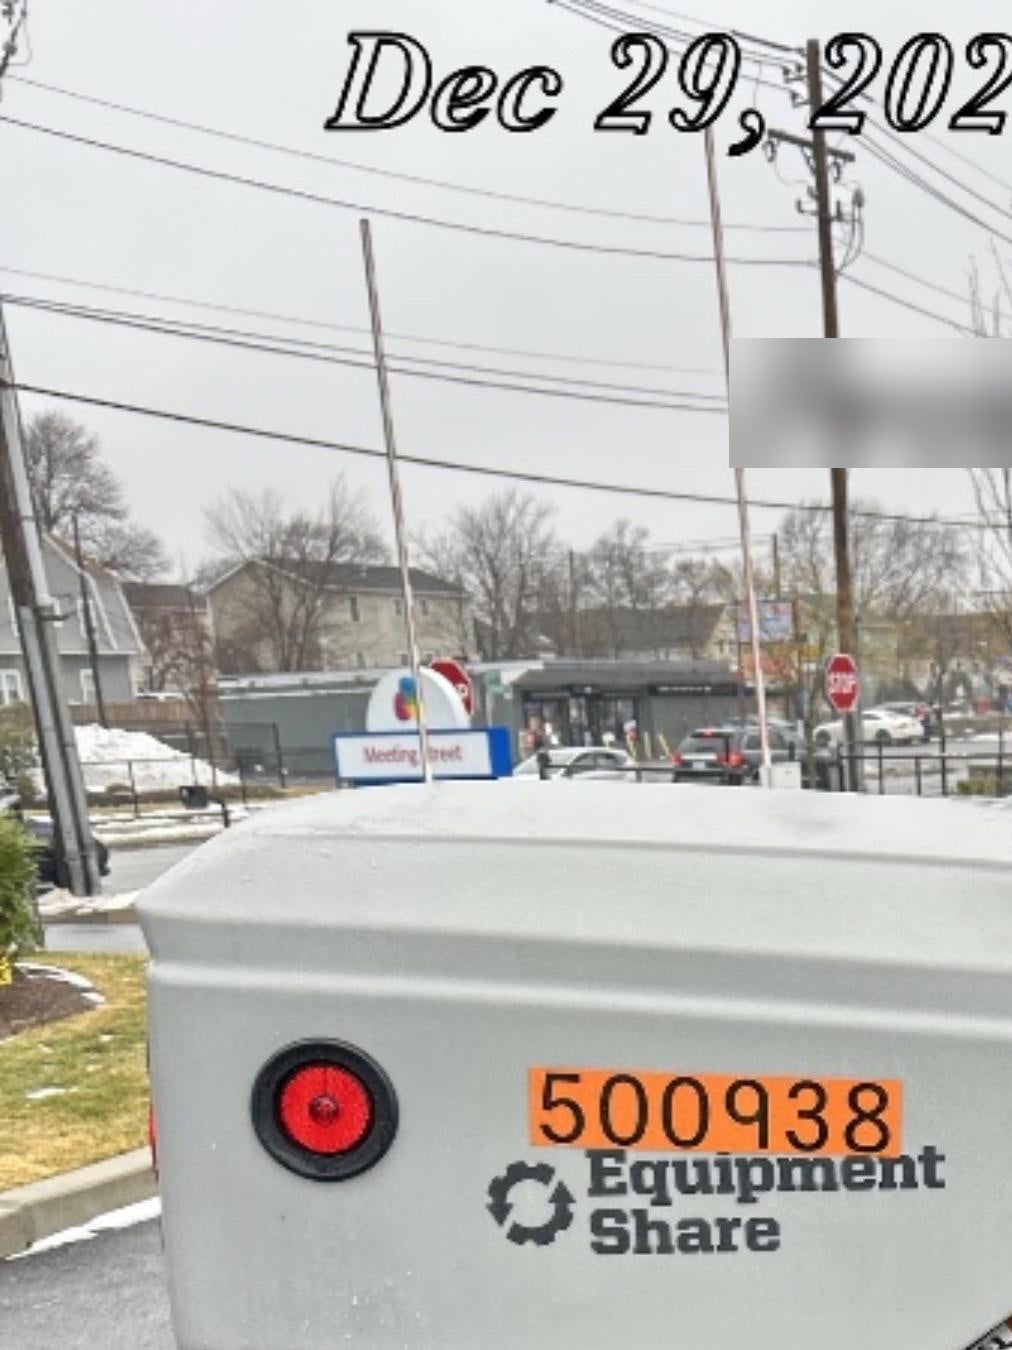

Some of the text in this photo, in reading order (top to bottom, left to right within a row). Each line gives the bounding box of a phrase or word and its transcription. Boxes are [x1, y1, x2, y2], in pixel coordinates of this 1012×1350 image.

[829, 672, 857, 694] STOP
[363, 744, 463, 767] Meeting treet
[539, 1073, 890, 1153] 500938
[585, 1146, 945, 1206] Equipment
[589, 1209, 781, 1254] Share
